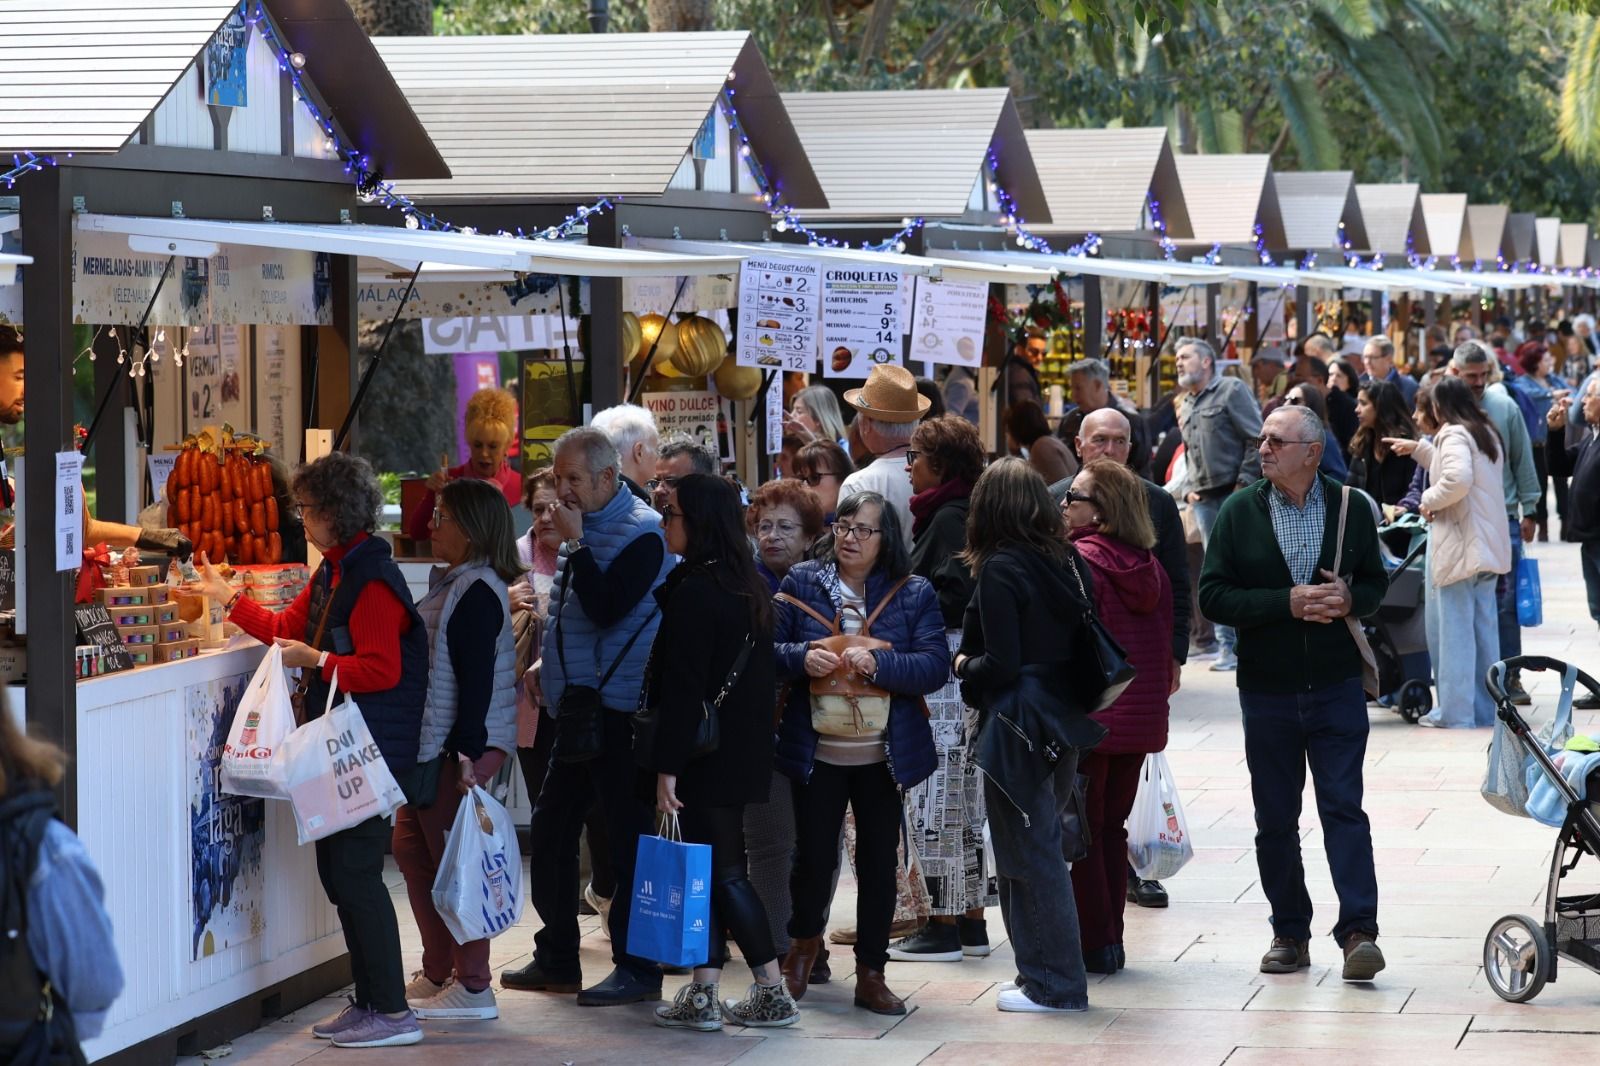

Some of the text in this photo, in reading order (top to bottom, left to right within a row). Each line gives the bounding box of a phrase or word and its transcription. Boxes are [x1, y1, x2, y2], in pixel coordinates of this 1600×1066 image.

[747, 260, 815, 273] MENÚ DEGUSTACIÓN
[826, 271, 898, 283] CROQUETAS
[190, 355, 219, 377] VERMUT
[647, 397, 714, 412] VINO DULCE
[659, 413, 714, 425] más premiado
[326, 729, 355, 756] DNI
[333, 742, 382, 778] MAKE
[337, 775, 363, 800] UP
[937, 773, 945, 788] THE
[935, 789, 944, 806] WALL
